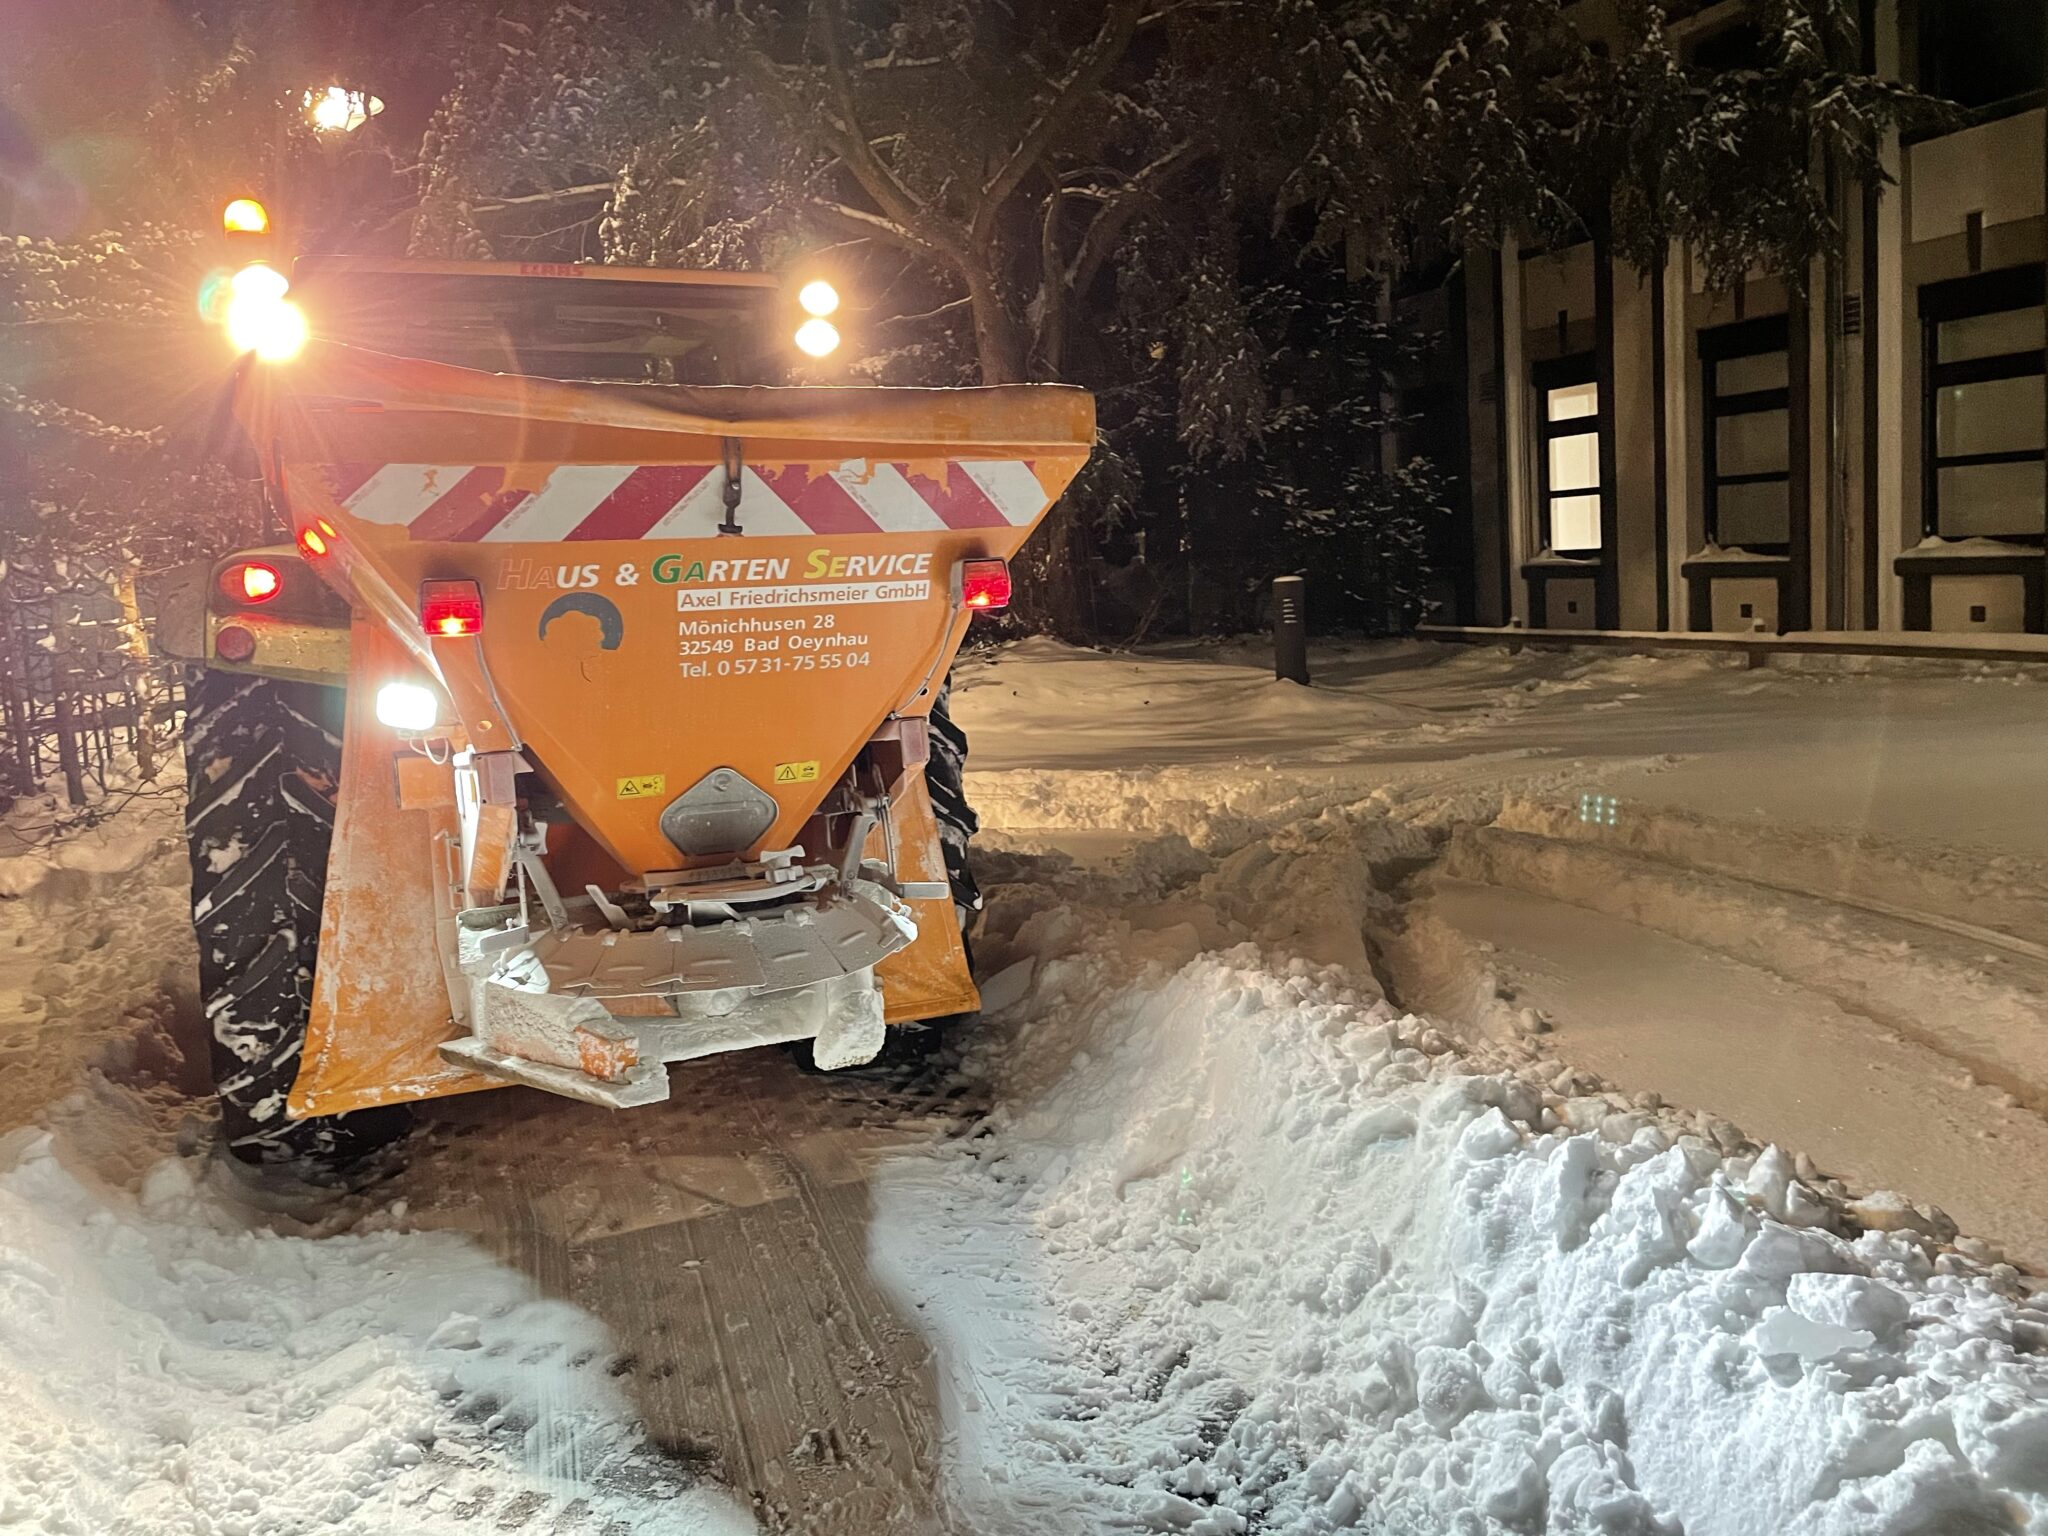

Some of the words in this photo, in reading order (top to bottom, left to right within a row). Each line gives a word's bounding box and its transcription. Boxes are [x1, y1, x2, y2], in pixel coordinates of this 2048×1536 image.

[615, 563, 640, 586] &
[651, 553, 790, 584] GARTEN
[803, 548, 933, 579] SERVICE
[680, 591, 721, 608] Axel
[730, 586, 869, 606] Friedrichsmeier
[875, 583, 927, 600] GmbH
[679, 617, 806, 636] Mönichhusen
[813, 614, 835, 629] 28
[679, 639, 734, 656] 32549
[744, 635, 779, 652] Bad
[788, 632, 868, 652] Oeynhau
[679, 660, 712, 678] Tel.
